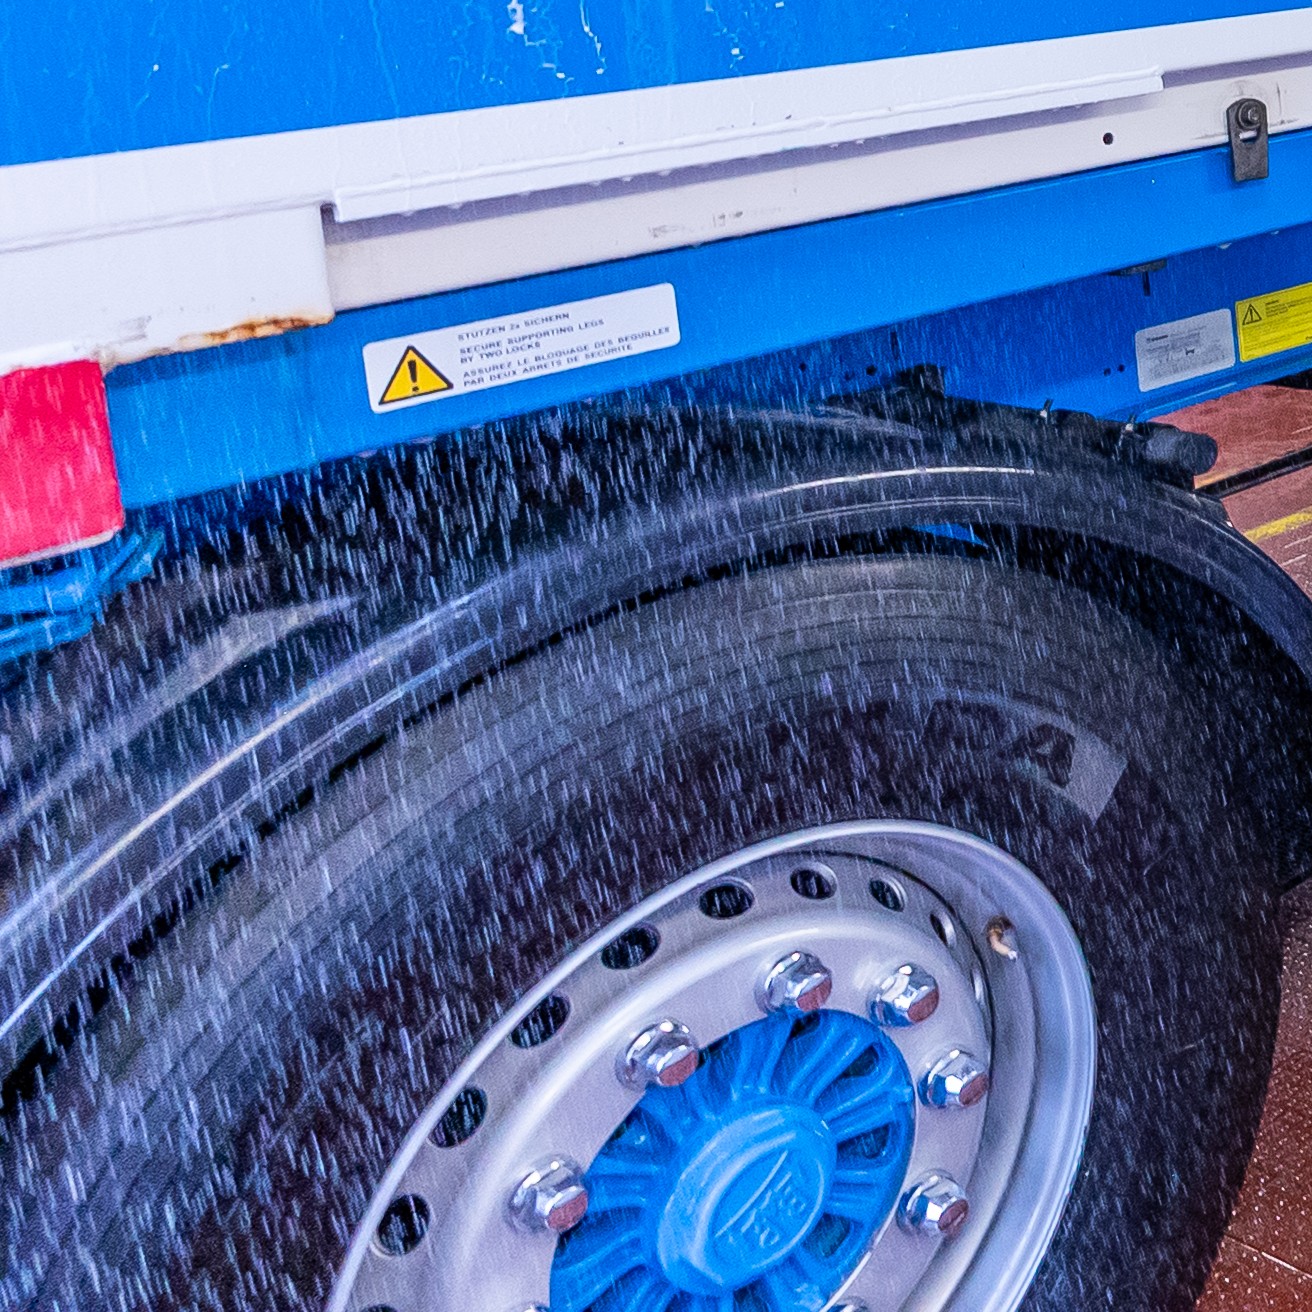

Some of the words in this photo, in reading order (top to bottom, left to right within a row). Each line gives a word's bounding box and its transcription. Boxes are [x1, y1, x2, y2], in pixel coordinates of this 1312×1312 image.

[524, 313, 570, 327] SICHERN
[460, 340, 501, 354] SECURE
[507, 326, 574, 344] SUPPORTING
[578, 319, 604, 330] LEGS
[460, 356, 473, 364] BY
[480, 350, 503, 360] TWO
[506, 341, 541, 355] LOCKS
[463, 361, 512, 378] ASSUREZ
[517, 358, 529, 366] LE
[594, 339, 613, 348] DES
[463, 377, 485, 387] PAR
[489, 370, 517, 381] DEUX
[566, 356, 578, 364] DE
